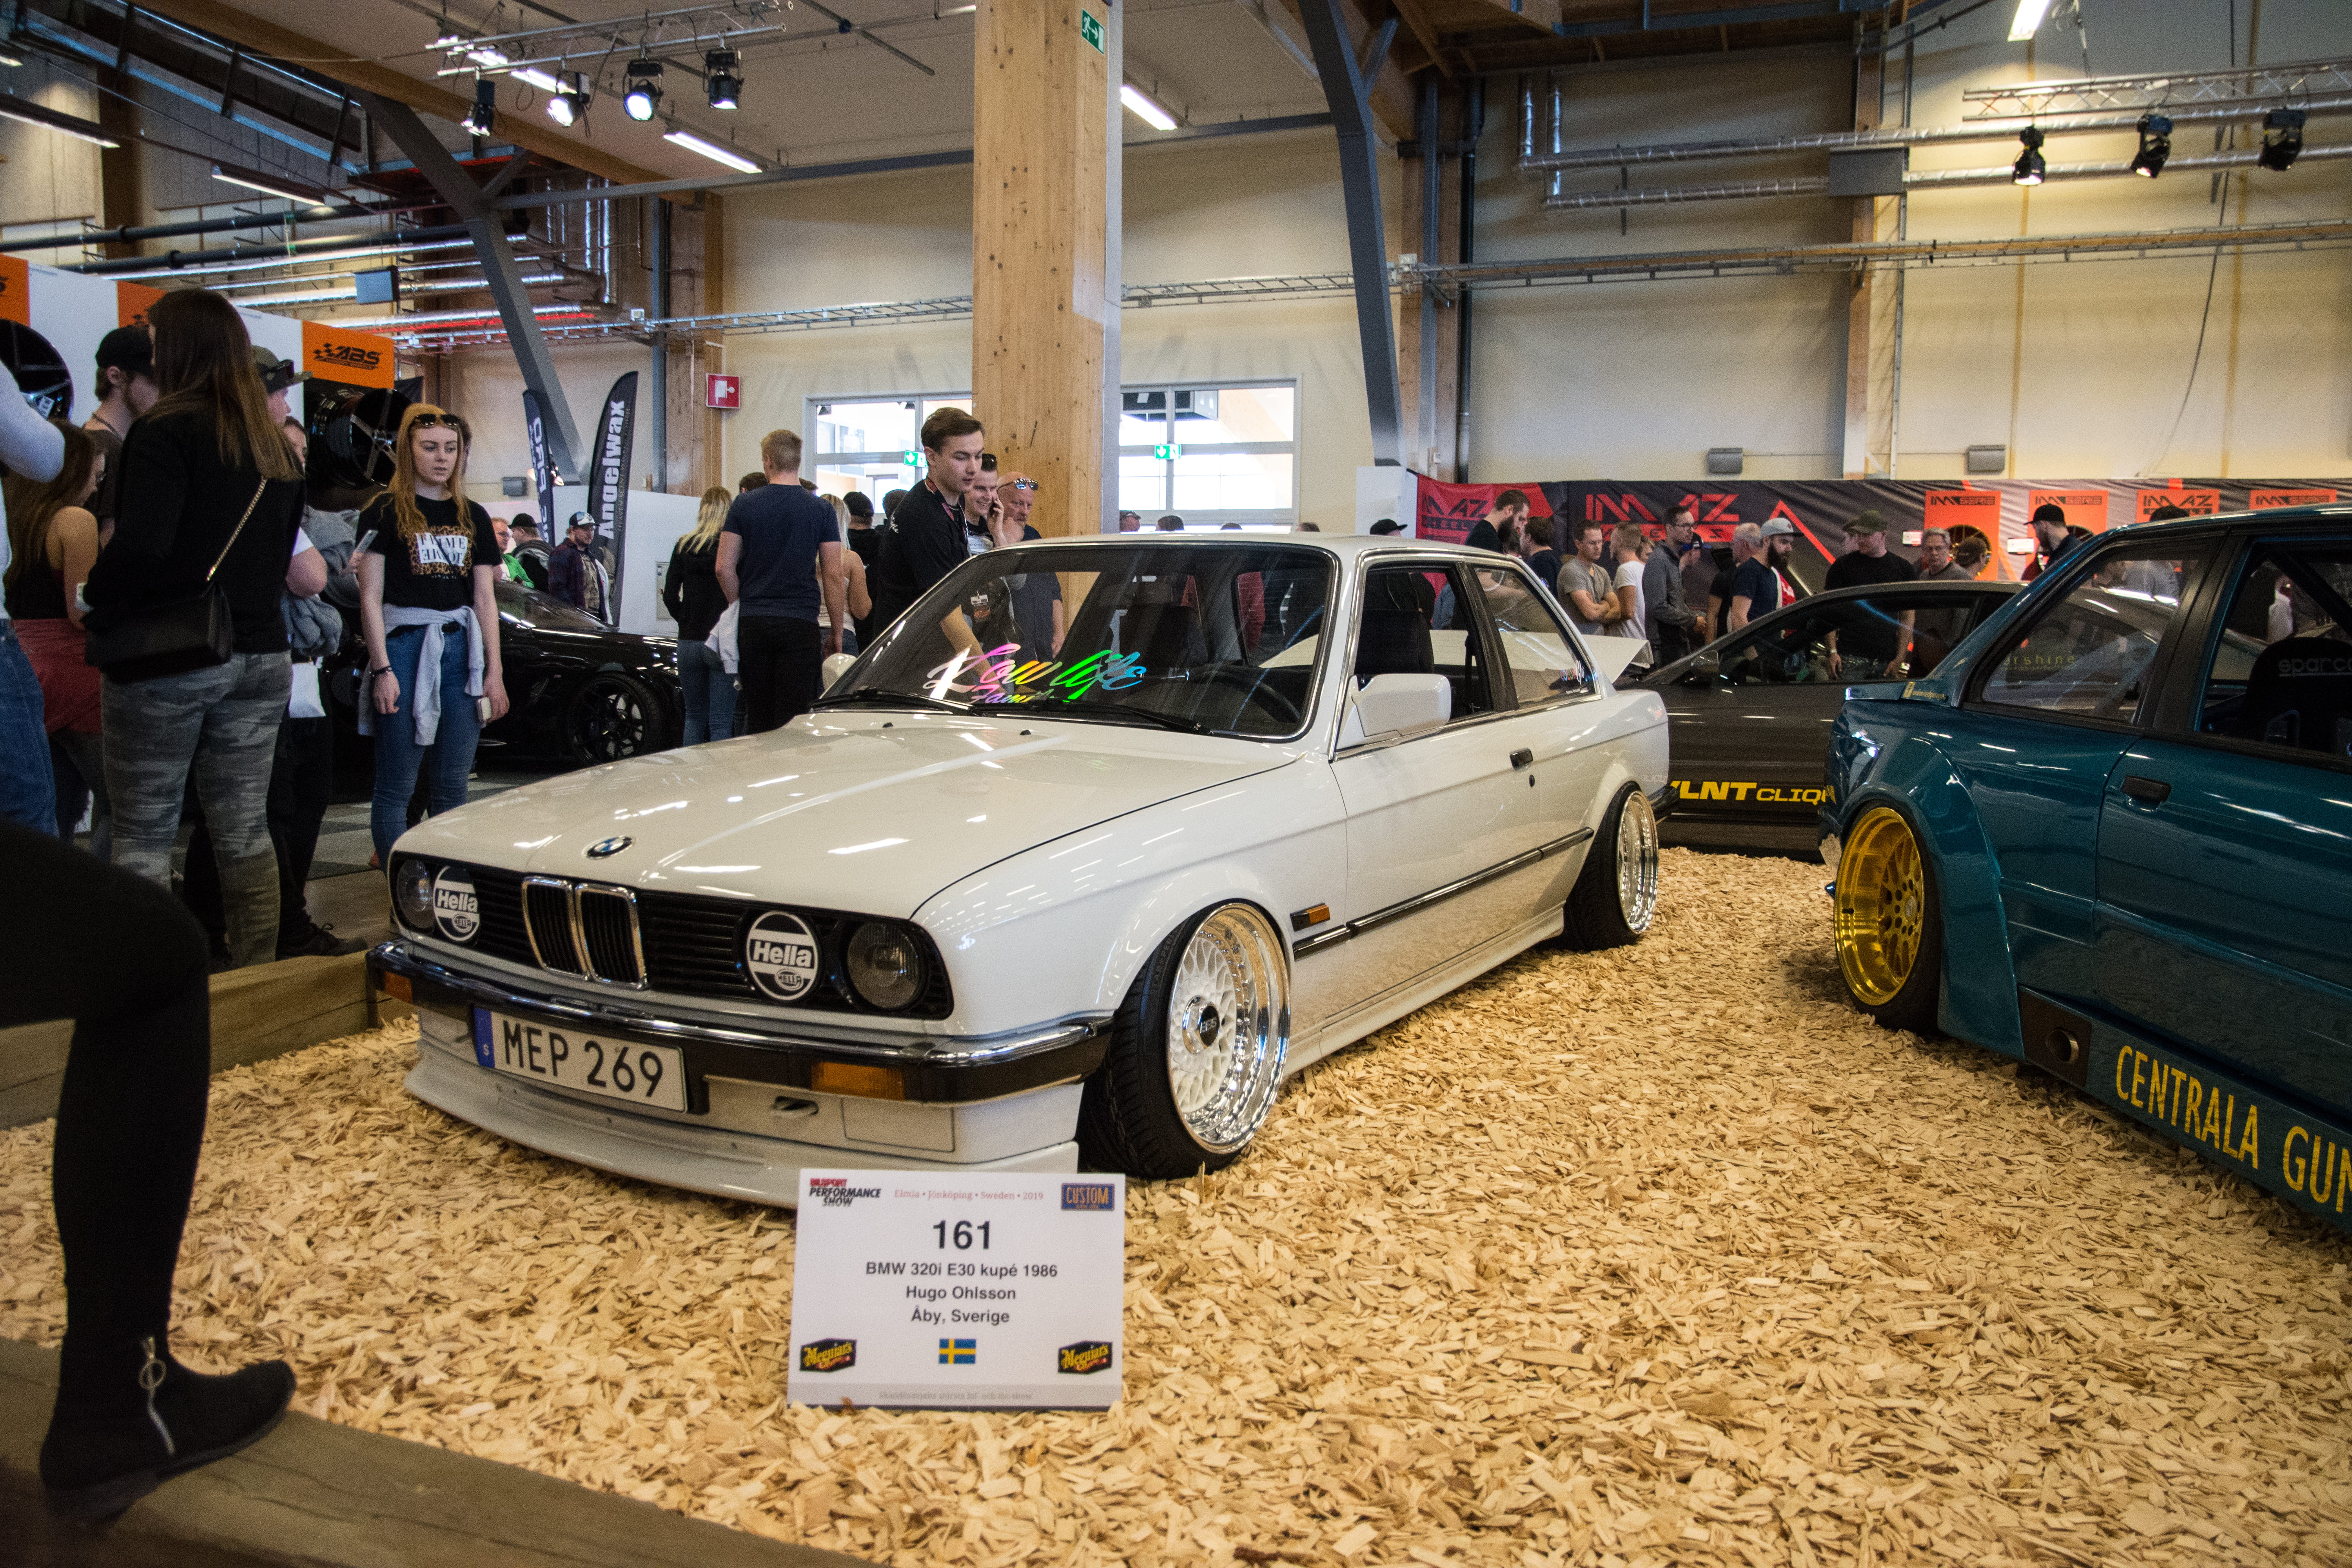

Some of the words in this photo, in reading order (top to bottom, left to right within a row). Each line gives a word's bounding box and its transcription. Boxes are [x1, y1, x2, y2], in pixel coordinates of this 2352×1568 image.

[336, 346, 383, 365] ABS
[437, 890, 478, 913] Hella
[753, 941, 812, 968] Hella
[483, 1044, 490, 1056] S
[503, 1020, 568, 1076] MEP
[584, 1040, 663, 1097] 269
[2116, 1045, 2258, 1170] CENTRALA
[809, 1187, 882, 1198] PERFORMANCE
[822, 1196, 854, 1207] SHOW
[894, 1189, 920, 1198] Elmia
[927, 1190, 973, 1201] Jönköping
[980, 1191, 1016, 1200] Sweden
[1022, 1192, 1044, 1200] 2019
[1066, 1187, 1109, 1204] CUSTOM
[933, 1220, 990, 1250] 161
[866, 1262, 906, 1275] BMW
[911, 1263, 942, 1276] 320i
[947, 1263, 975, 1276] E30
[981, 1263, 1018, 1279] kupé
[1023, 1265, 1058, 1277] 1986
[906, 1286, 947, 1302] Hugo
[952, 1286, 1016, 1300] Ohlsson
[911, 1305, 946, 1325] Åby,
[951, 1309, 1010, 1326] Sverige
